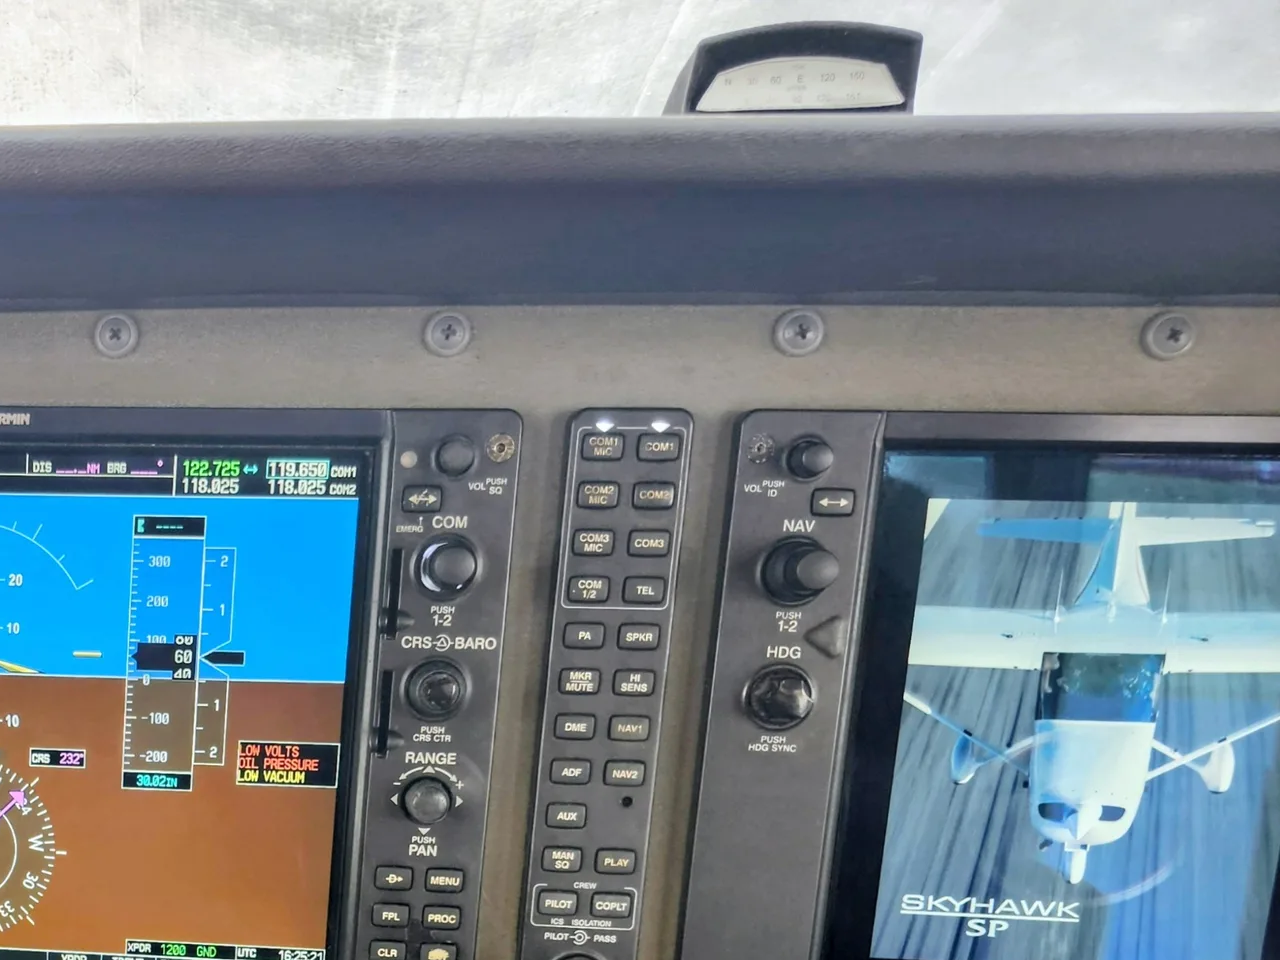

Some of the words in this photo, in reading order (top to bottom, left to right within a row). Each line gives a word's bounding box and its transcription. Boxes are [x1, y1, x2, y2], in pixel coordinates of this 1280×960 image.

[32, 461, 52, 473] DIS
[107, 462, 127, 473] BRG
[183, 460, 240, 476] 122.725
[269, 461, 327, 477] 119.650
[330, 467, 357, 478] COM1
[182, 478, 239, 494] 118.025
[268, 479, 326, 495] 118.025
[329, 484, 356, 495] COM2
[432, 516, 468, 529] COM
[783, 519, 815, 532] NAV
[149, 555, 171, 567] 300
[147, 596, 169, 607] 200
[401, 637, 432, 649] CRS
[454, 637, 497, 650] BARO
[626, 632, 653, 642] SPKR
[174, 650, 193, 664] 60
[766, 646, 801, 659] HDG
[565, 722, 587, 732] DME
[239, 745, 260, 756] LOW
[265, 746, 300, 758] VOLTS
[31, 753, 50, 764] CRS
[238, 757, 260, 769] OIL
[264, 758, 319, 771] PRESSURE
[405, 752, 457, 765] RANGE
[238, 771, 258, 782] LOW
[263, 771, 305, 784] VACUUM
[430, 875, 460, 886] MENU
[545, 899, 573, 910] PILOT
[901, 893, 1080, 918] SKYHAWK
[428, 914, 456, 924] PROC
[965, 920, 1009, 938] SP
[127, 942, 151, 954] XPDR
[160, 944, 186, 957] 1200
[196, 946, 217, 958] GND
[237, 947, 257, 959] UTC
